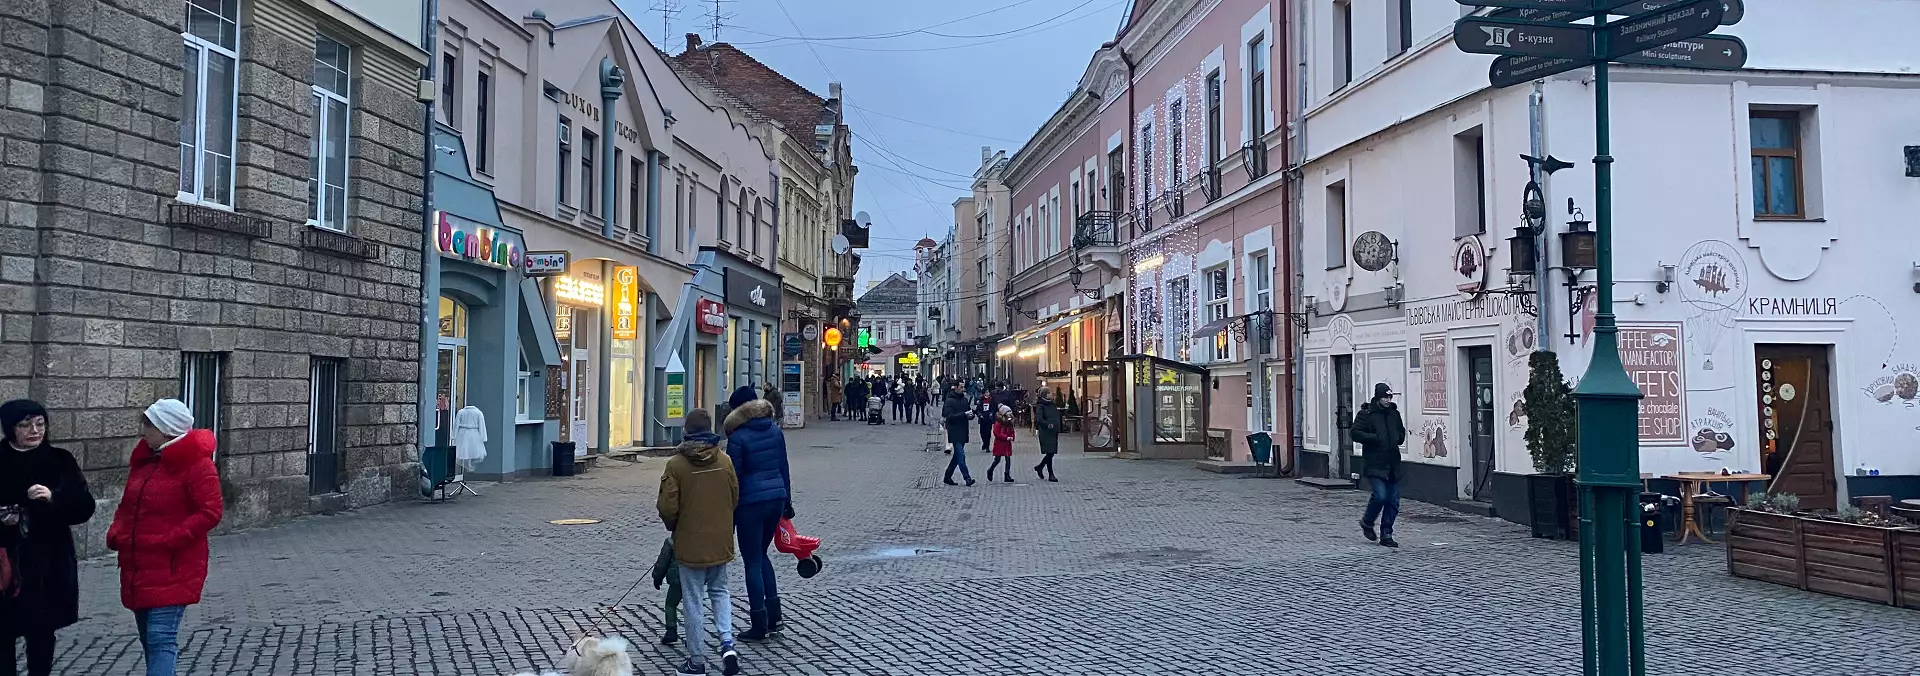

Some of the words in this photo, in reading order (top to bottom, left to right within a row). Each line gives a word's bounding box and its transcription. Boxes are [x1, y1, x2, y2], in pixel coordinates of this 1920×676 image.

[1667, 7, 1694, 22] вокзал
[1518, 32, 1554, 44] Б-кузня
[1658, 52, 1692, 61] sculptures
[1510, 64, 1537, 77] Monument
[1543, 59, 1553, 68] the
[565, 92, 599, 122] LUXOR
[438, 211, 520, 268] bambino
[526, 255, 564, 268] bambino
[1748, 297, 1837, 315] КРАМНИЦЯ
[1626, 371, 1679, 397] EETS
[1647, 400, 1679, 414] chocolate
[1653, 417, 1680, 436] SHOP
